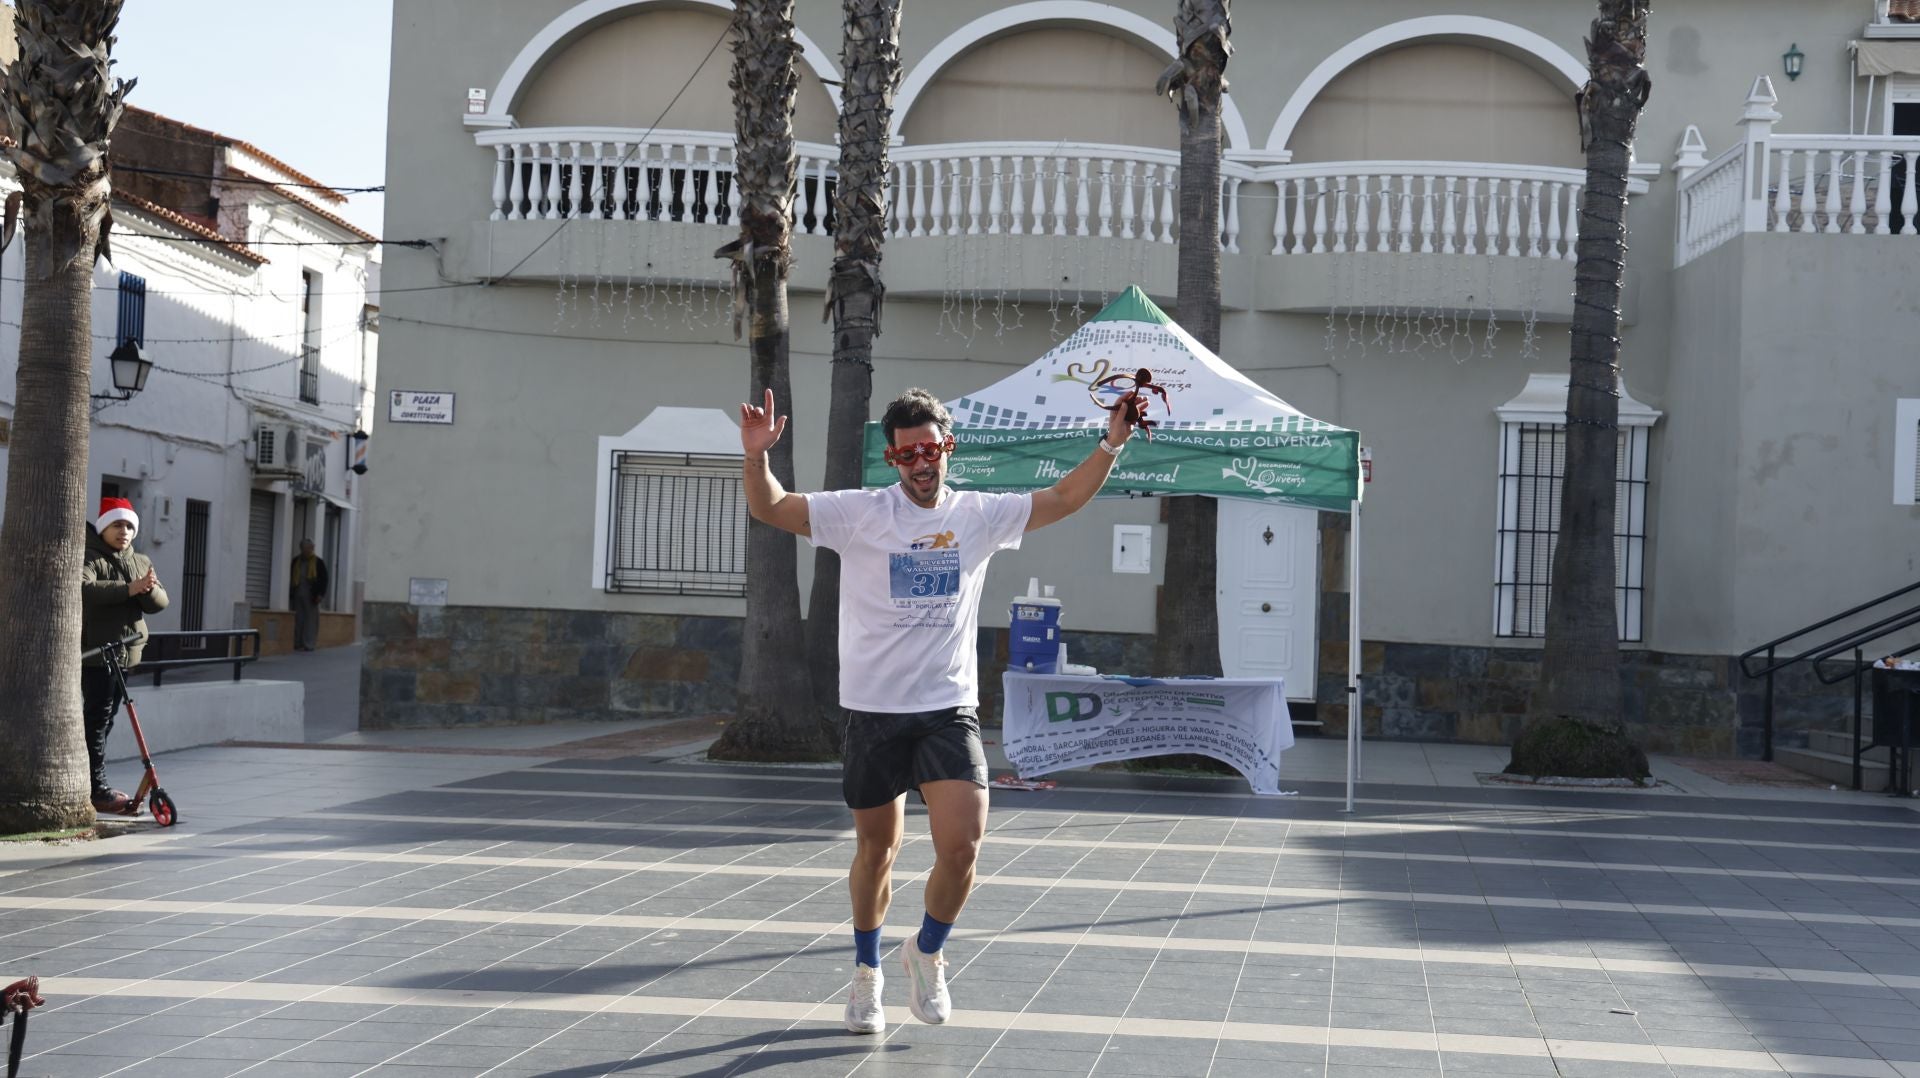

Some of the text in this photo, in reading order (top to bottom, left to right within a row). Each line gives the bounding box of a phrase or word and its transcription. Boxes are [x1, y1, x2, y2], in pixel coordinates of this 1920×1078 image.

[412, 395, 441, 405] PLAZA
[1021, 429, 1094, 442] INTEGRAL
[1146, 433, 1225, 447] COMARCA
[1230, 436, 1249, 447] DE
[1253, 434, 1333, 448] OLIVENZA
[910, 571, 949, 597] 31
[1106, 727, 1135, 737] CHELES
[1189, 726, 1219, 737] VARGAS
[1120, 737, 1130, 745] DE
[1131, 733, 1166, 744] LEGANÉS
[1173, 734, 1219, 745] VILLANUEVA
[1220, 740, 1233, 751] DEL
